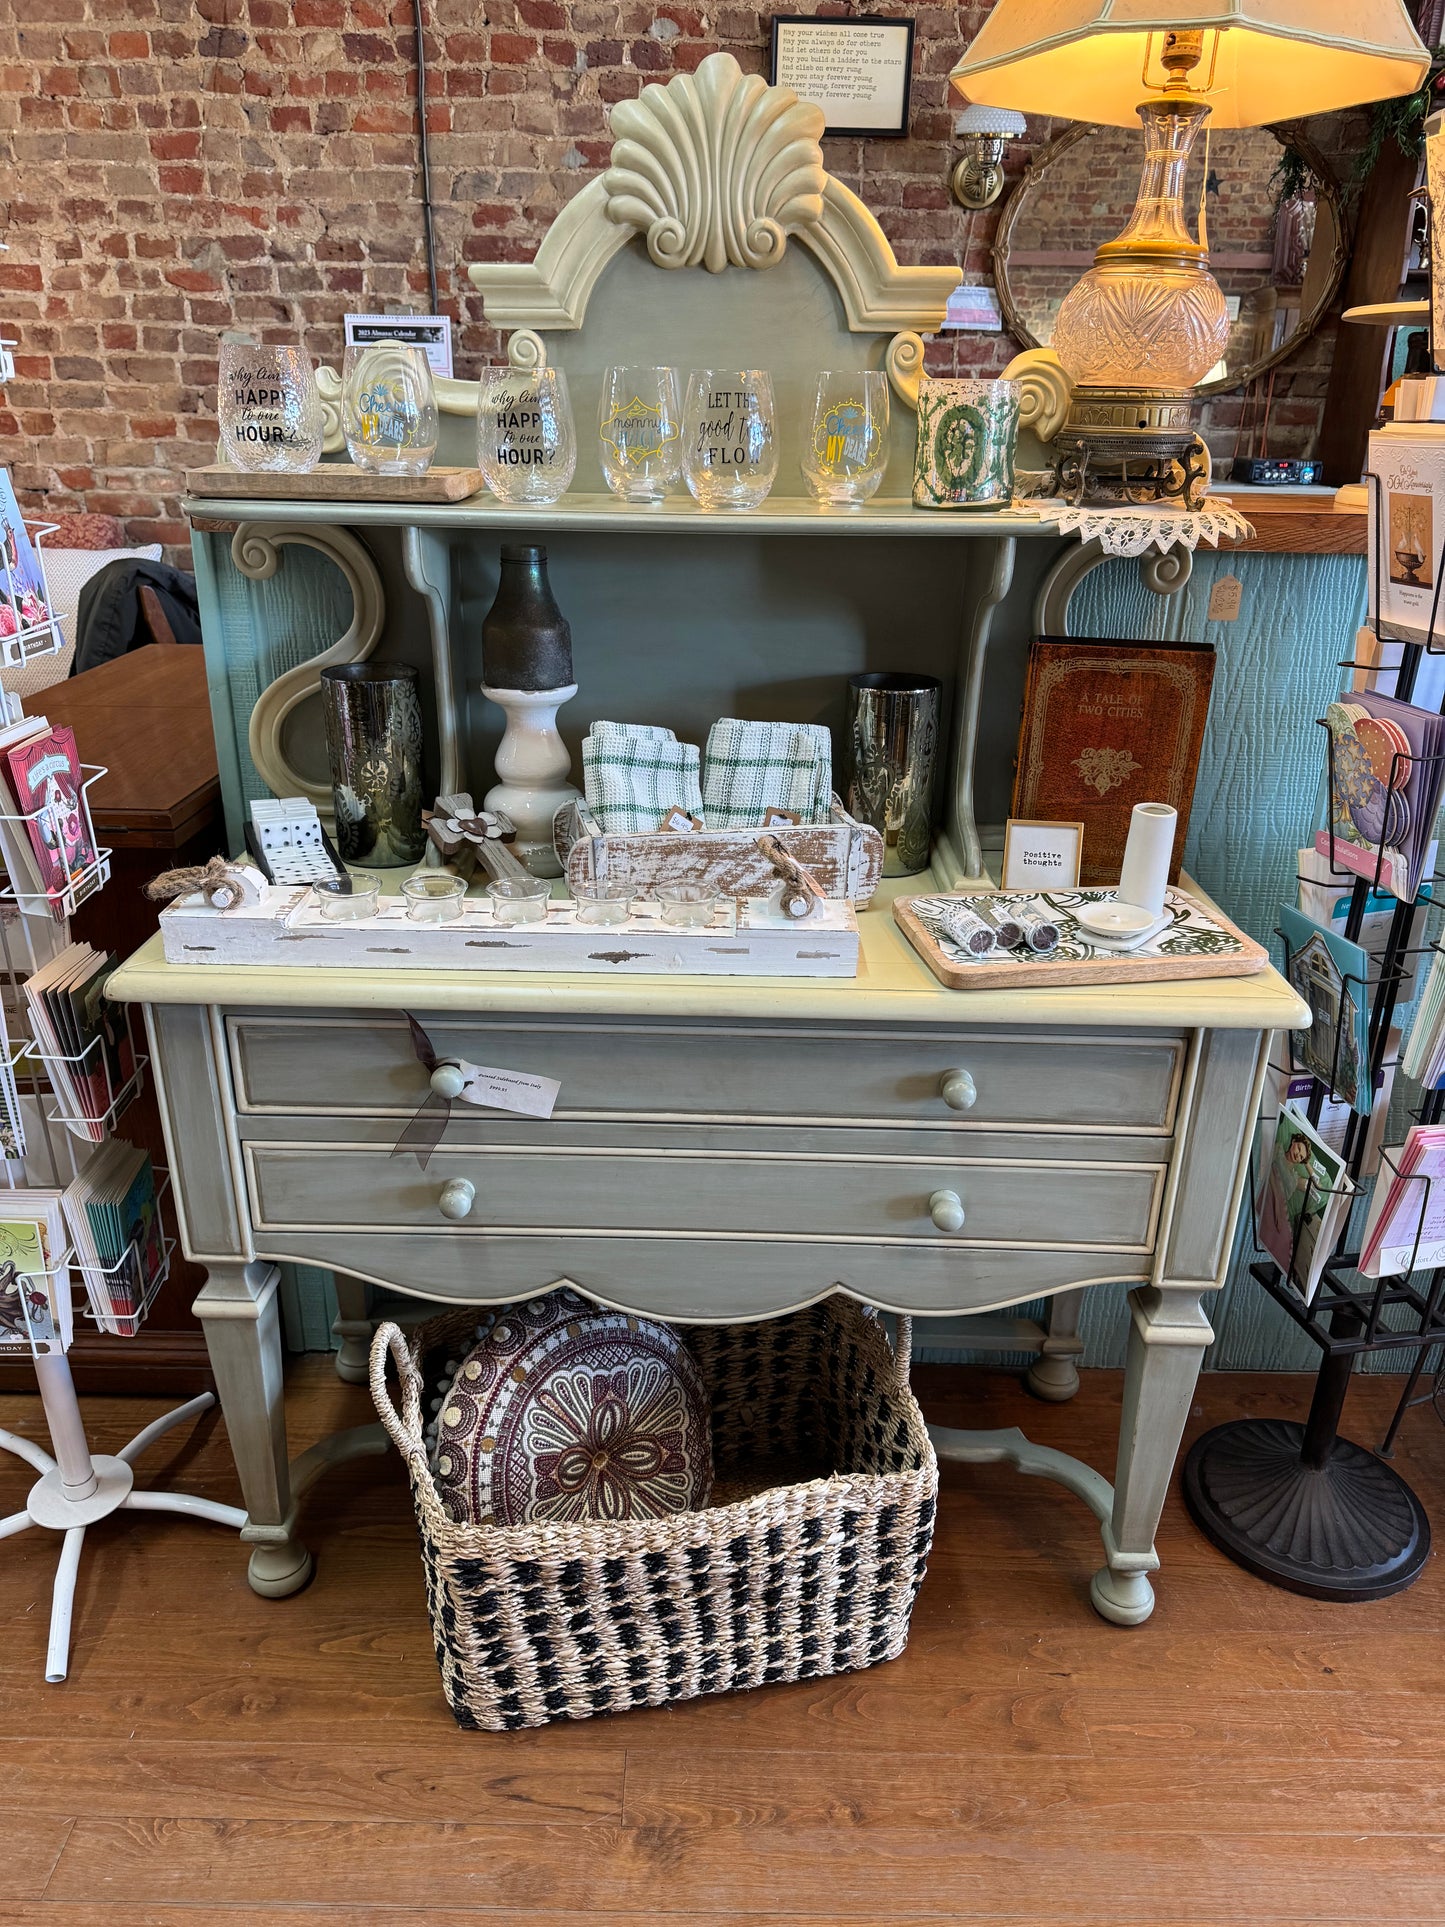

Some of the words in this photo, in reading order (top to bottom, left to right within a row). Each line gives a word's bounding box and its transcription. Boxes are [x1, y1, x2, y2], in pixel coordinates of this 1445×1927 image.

[783, 29, 795, 37] May
[815, 29, 838, 37] wishes
[840, 30, 851, 38] all
[870, 31, 885, 39] true
[783, 38, 795, 46] May
[811, 39, 835, 47] always
[847, 39, 858, 47] for
[782, 55, 795, 63] May
[811, 55, 829, 63] build
[856, 49, 868, 57] you
[782, 72, 794, 80] May
[810, 73, 825, 82] stay
[853, 75, 873, 83] young
[846, 67, 862, 75] rung
[831, 82, 856, 90] forever
[857, 84, 877, 92] young
[852, 92, 872, 101] young
[393, 329, 417, 337] Calendar
[491, 389, 515, 411] why
[708, 392, 732, 408] LET
[734, 392, 757, 408] TH
[241, 406, 254, 420] to
[497, 412, 541, 428] HAPP
[361, 413, 379, 443] MY
[696, 410, 735, 452] good
[503, 430, 516, 444] to
[519, 434, 541, 443] one
[708, 447, 760, 464] FLO
[826, 435, 846, 463] MY
[843, 436, 868, 464] DEARS
[497, 448, 556, 465] HOUR?
[1081, 692, 1089, 702] A
[1094, 693, 1123, 705] TALE
[1129, 694, 1144, 705] OF
[1077, 704, 1104, 716] TWO
[1107, 706, 1144, 718] CITIES
[1023, 851, 1062, 859] Positive
[1023, 858, 1063, 867] thoughts
